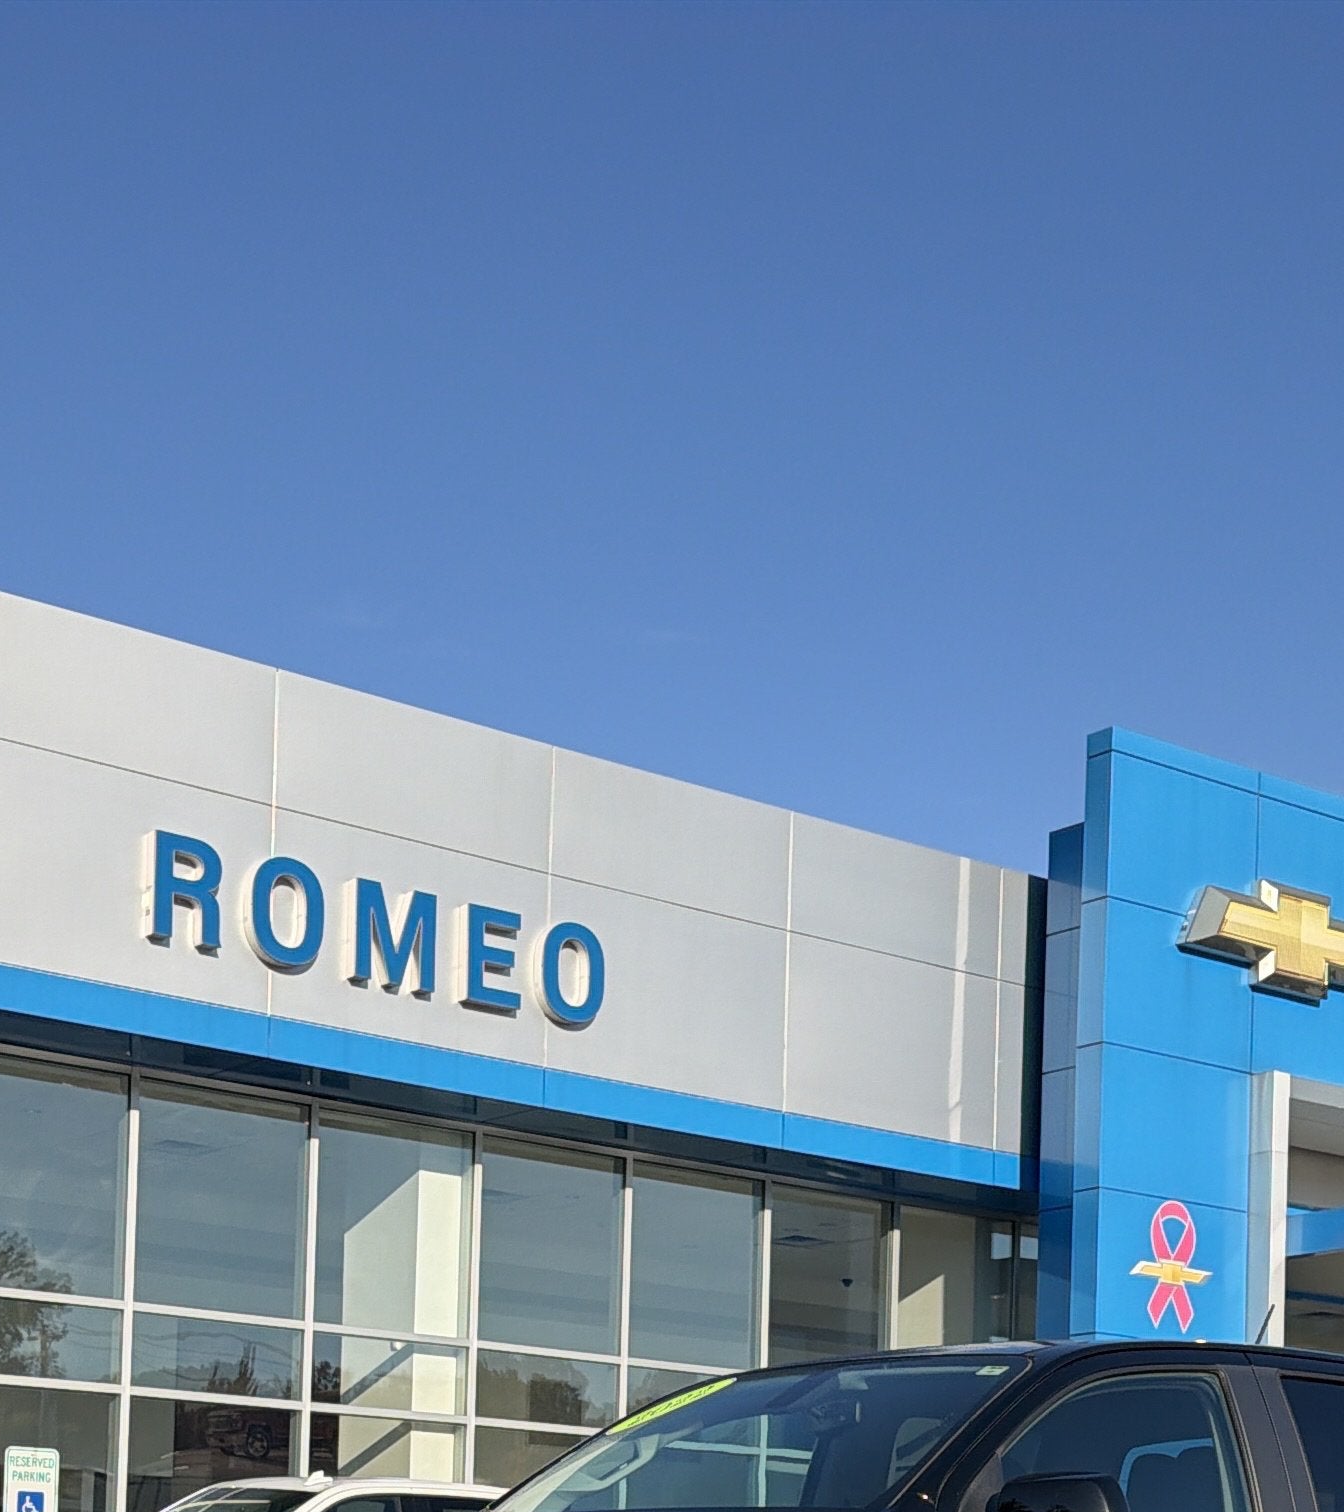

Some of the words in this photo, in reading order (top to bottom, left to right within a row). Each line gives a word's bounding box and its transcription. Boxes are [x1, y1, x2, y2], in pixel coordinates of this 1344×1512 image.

[143, 829, 606, 1028] ROMEO
[9, 1455, 55, 1469] RESERVED
[11, 1470, 52, 1484] PARKING
